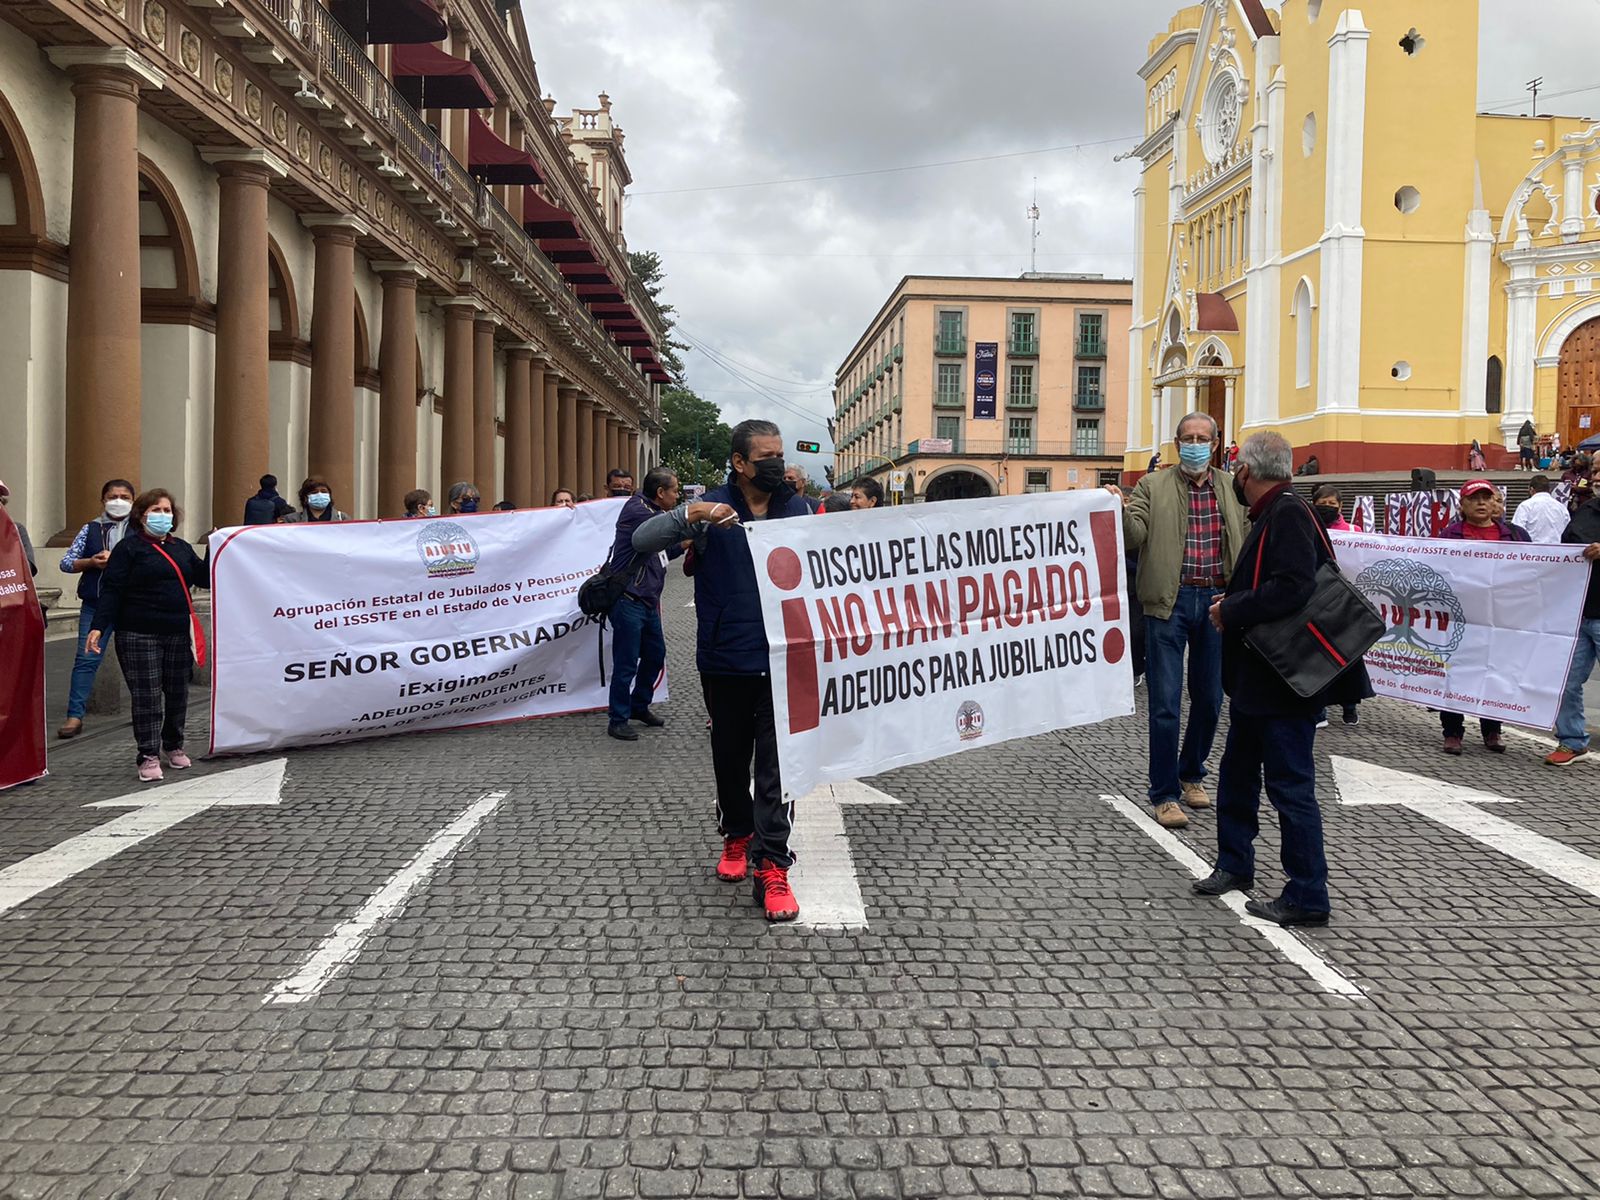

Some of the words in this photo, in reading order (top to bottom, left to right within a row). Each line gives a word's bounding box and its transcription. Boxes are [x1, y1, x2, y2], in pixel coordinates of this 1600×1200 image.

[806, 536, 918, 589] DISCULPE
[921, 531, 963, 572] LAS
[965, 519, 1086, 560] MOLESTIAS,
[1331, 538, 1346, 547] dos
[1354, 541, 1405, 553] pensionados
[1407, 545, 1420, 554] del
[1421, 547, 1448, 556] ISSSTE
[1450, 549, 1461, 557] en
[1463, 549, 1472, 558] el
[1474, 551, 1504, 560] estado
[1506, 552, 1518, 561] de
[1520, 552, 1560, 564] Veracruz
[1563, 555, 1584, 564] A.C.
[0, 568, 17, 579] sas
[273, 598, 366, 619] Agrupación
[372, 591, 422, 607] Estatal
[427, 590, 445, 600] de
[449, 582, 511, 598] Jubilados
[515, 582, 523, 591] y
[314, 618, 338, 630] del
[343, 610, 397, 627] ISSSTE
[402, 609, 421, 619] en
[425, 605, 438, 616] el
[443, 601, 488, 614] Estado
[492, 597, 509, 607] de
[513, 586, 578, 604] Veracruz
[815, 592, 873, 663] NO
[873, 579, 952, 650] HAN
[957, 560, 1092, 636] PAGADO
[284, 651, 400, 683] SEÑOR
[410, 612, 601, 666] GOBERNADOR
[399, 664, 519, 698] ¡Exigimos!
[821, 658, 926, 717] ADEUDOS
[929, 647, 986, 693] PARA
[988, 628, 1097, 682] JUBILADOS
[1400, 682, 1431, 695] derechos
[1433, 688, 1442, 696] de
[351, 699, 444, 723] -ADEUDOS
[449, 673, 547, 706] PENDIENTES
[502, 683, 567, 705] VIGENTE
